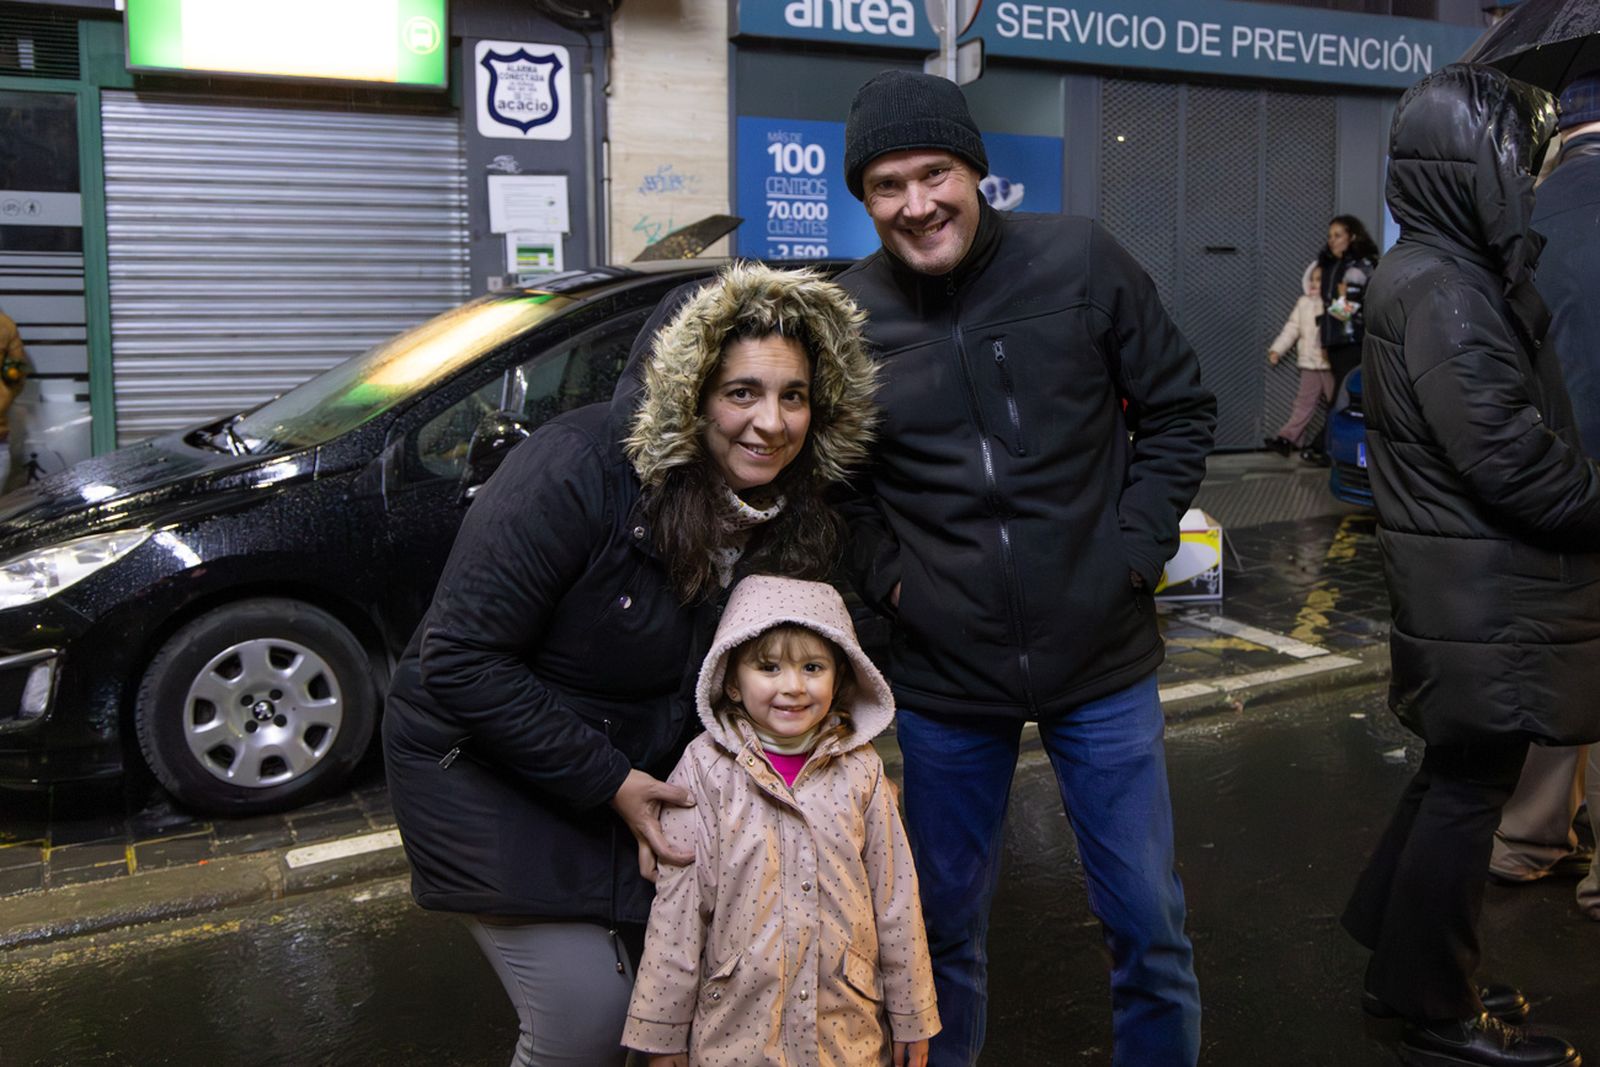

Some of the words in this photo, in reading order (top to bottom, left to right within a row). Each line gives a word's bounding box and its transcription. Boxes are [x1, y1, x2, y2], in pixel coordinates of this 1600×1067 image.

[784, 0, 915, 37] antea
[996, 2, 1166, 51] SERVICIO
[1176, 20, 1221, 57] DE
[1231, 25, 1433, 74] PREVENCIÓN
[498, 99, 548, 111] acacio
[767, 142, 825, 175] 100
[766, 176, 828, 195] CENTROS
[766, 201, 828, 220] 70.000
[766, 219, 828, 236] CLIENTES
[777, 244, 829, 258] 2500
